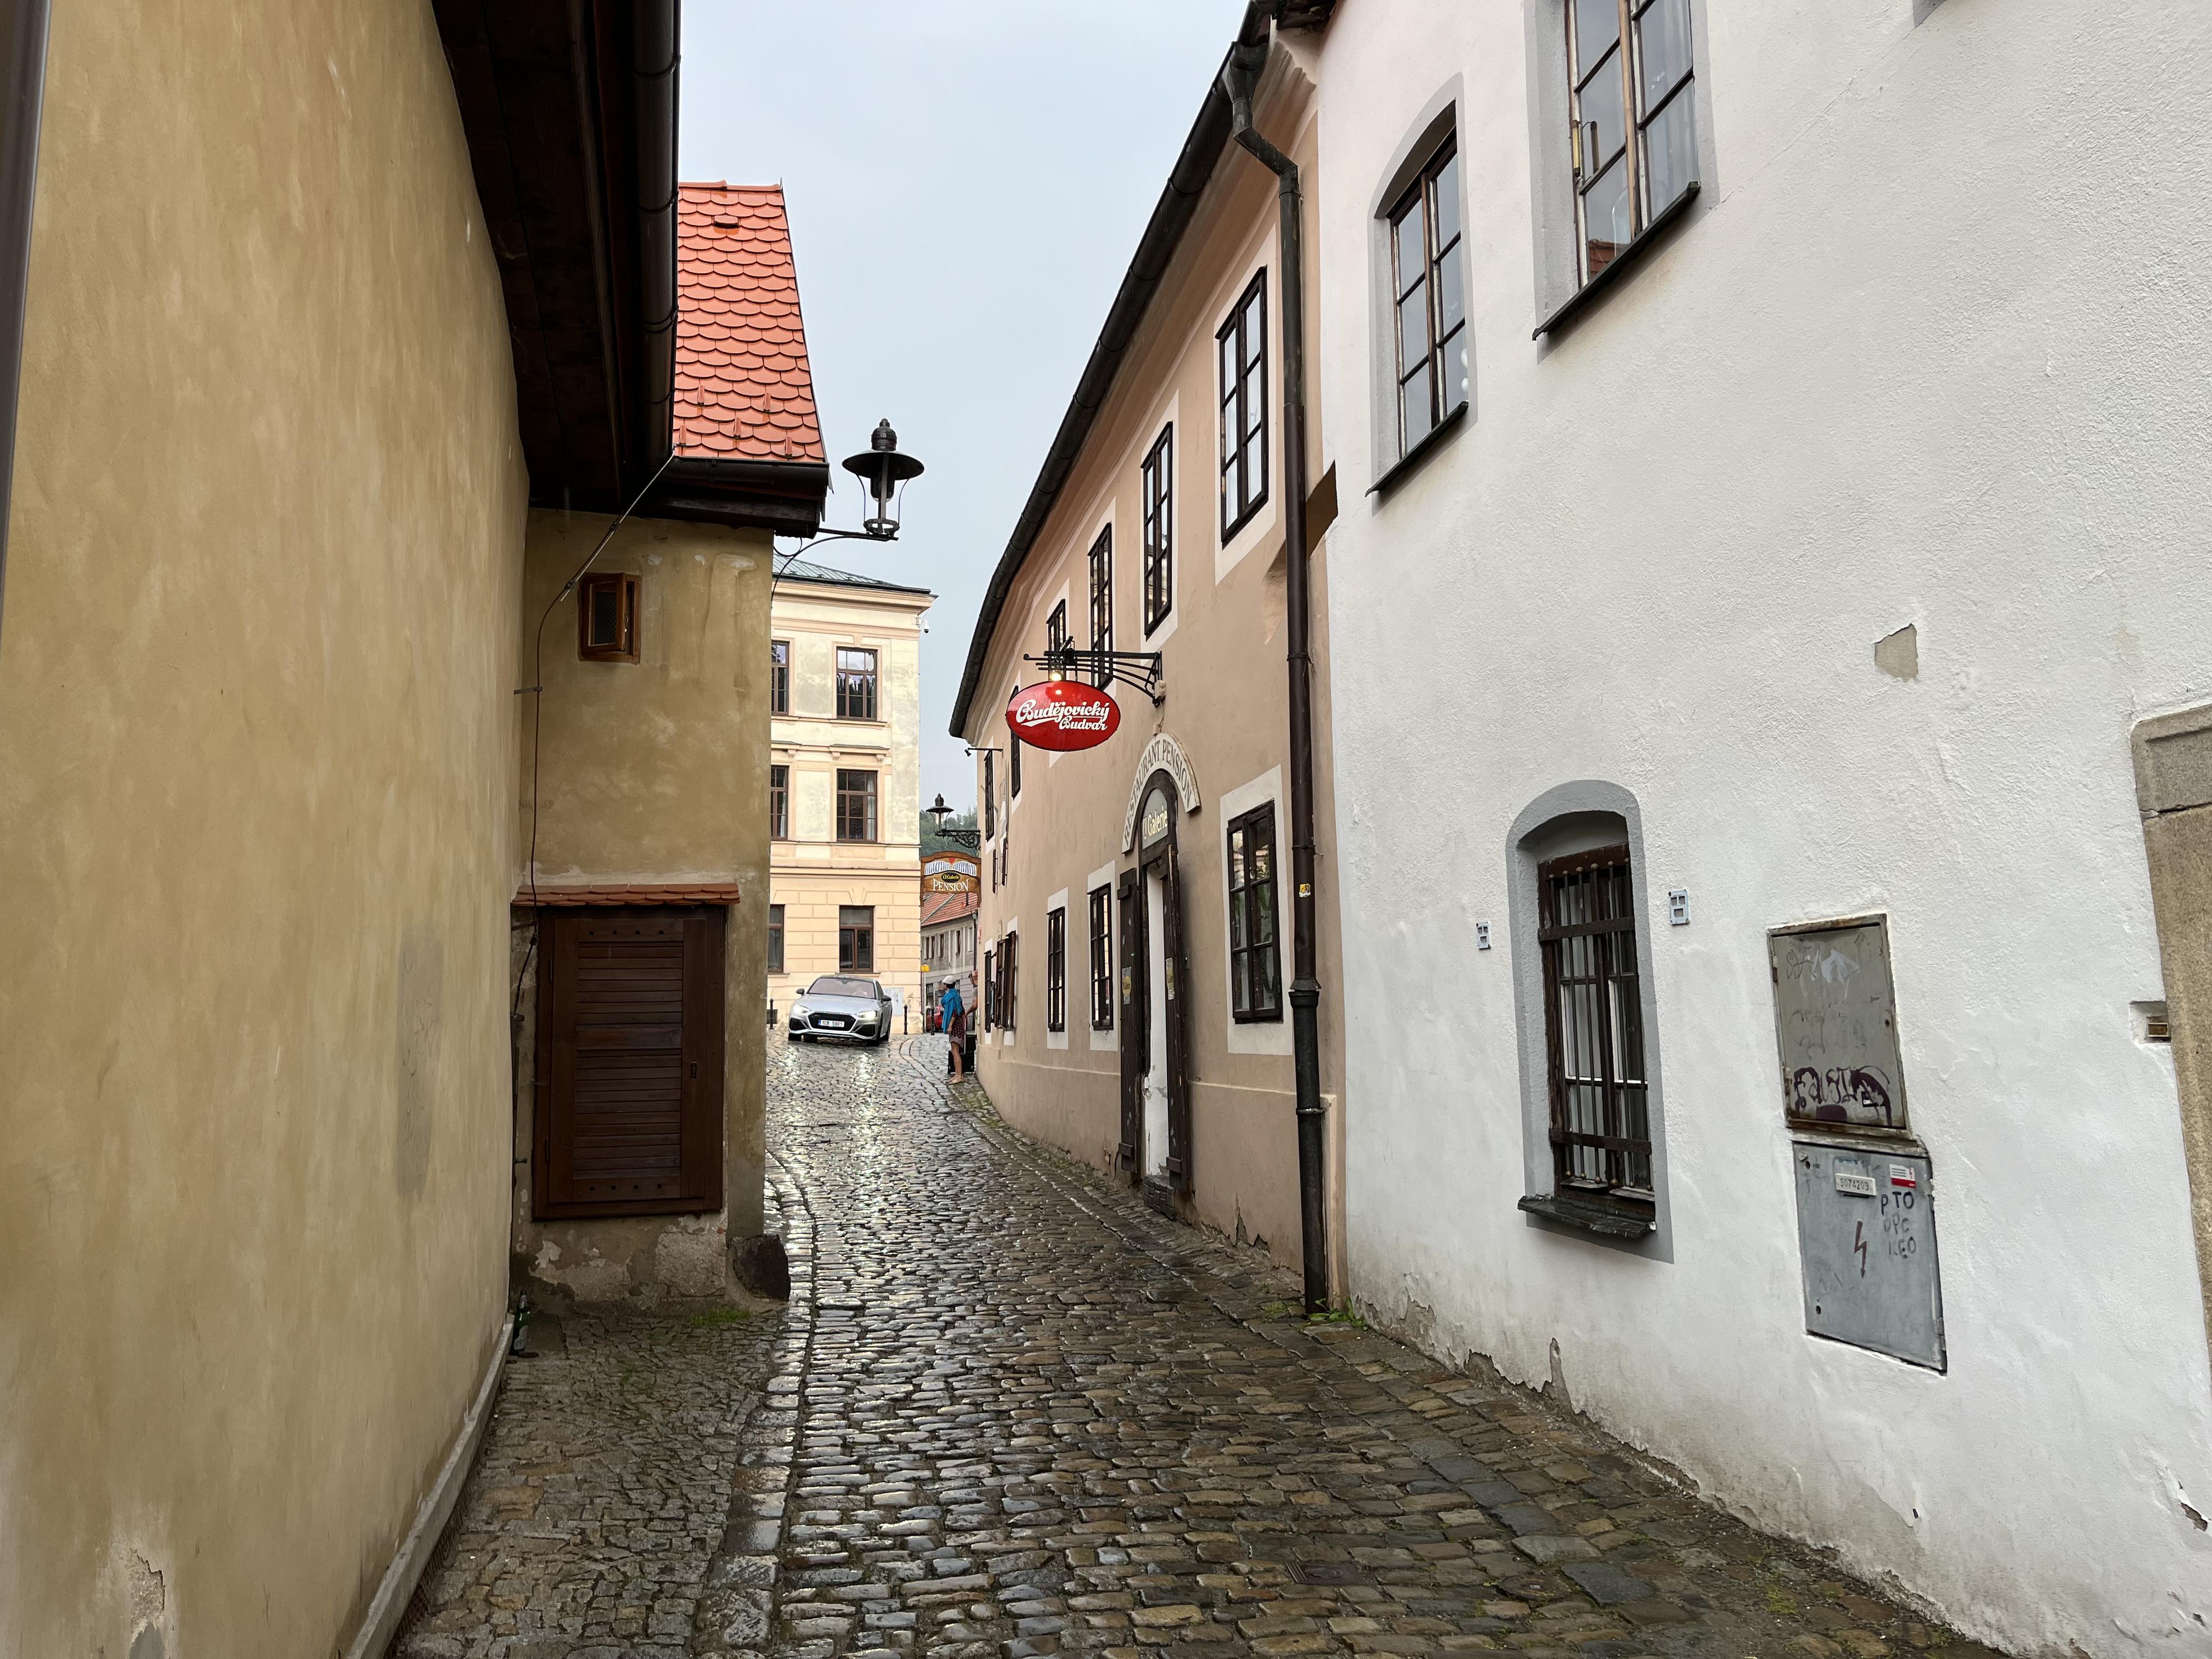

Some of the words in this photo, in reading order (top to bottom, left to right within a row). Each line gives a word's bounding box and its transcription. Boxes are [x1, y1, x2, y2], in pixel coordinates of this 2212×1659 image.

[1016, 699, 1110, 723] Budějovický
[1059, 716, 1108, 731] Budvar
[1125, 739, 1161, 846] RESTAURANT
[1162, 739, 1192, 809] PENSION
[1148, 804, 1168, 837] Galerie
[932, 878, 969, 891] PENSION
[1881, 1191, 1914, 1215] PTO
